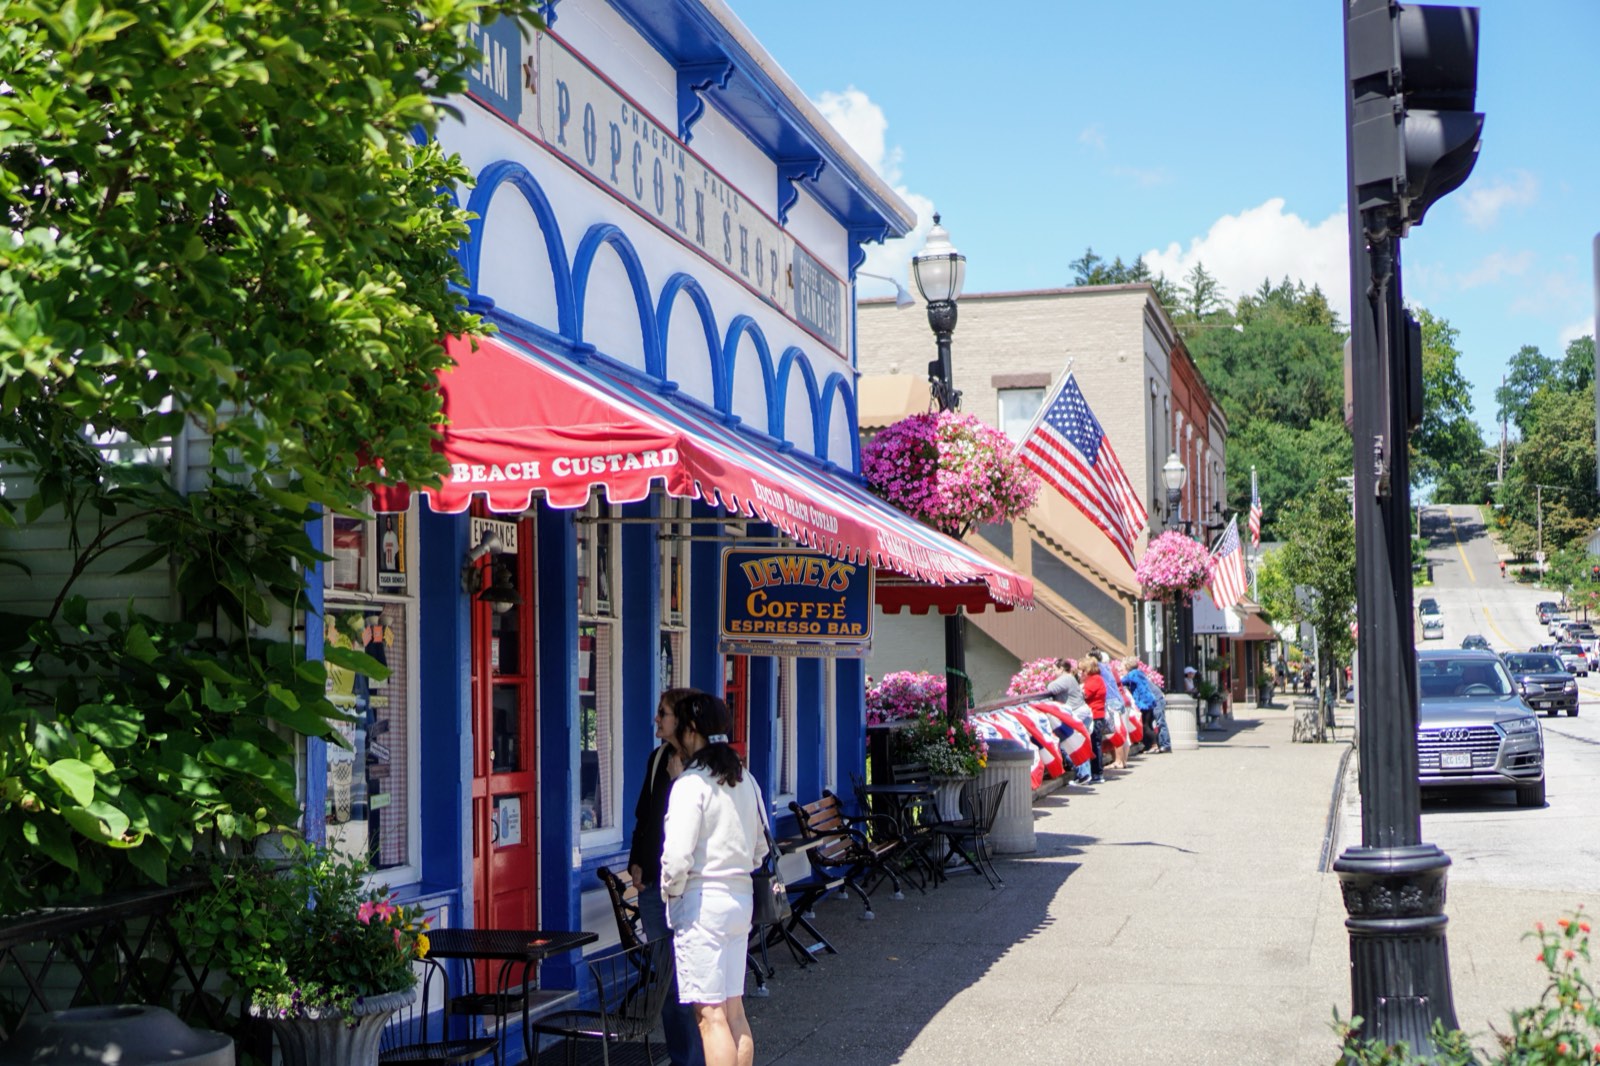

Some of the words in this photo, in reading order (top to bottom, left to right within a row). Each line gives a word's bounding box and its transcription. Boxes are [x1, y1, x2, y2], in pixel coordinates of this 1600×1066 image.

[457, 20, 508, 101] EAM
[621, 103, 685, 172] CHAGRIN
[703, 169, 739, 214] FALLS
[556, 78, 705, 248] POPCORN
[722, 210, 778, 298] SHOP
[801, 281, 836, 338] CANDIES
[450, 461, 541, 483] BEACH
[551, 448, 680, 477] CUSTARD
[751, 478, 784, 511] EUCLID
[783, 492, 809, 523] BEACH
[809, 505, 839, 534] CUSTARD
[731, 619, 821, 634] ESPRESSO
[827, 622, 862, 635] BAR
